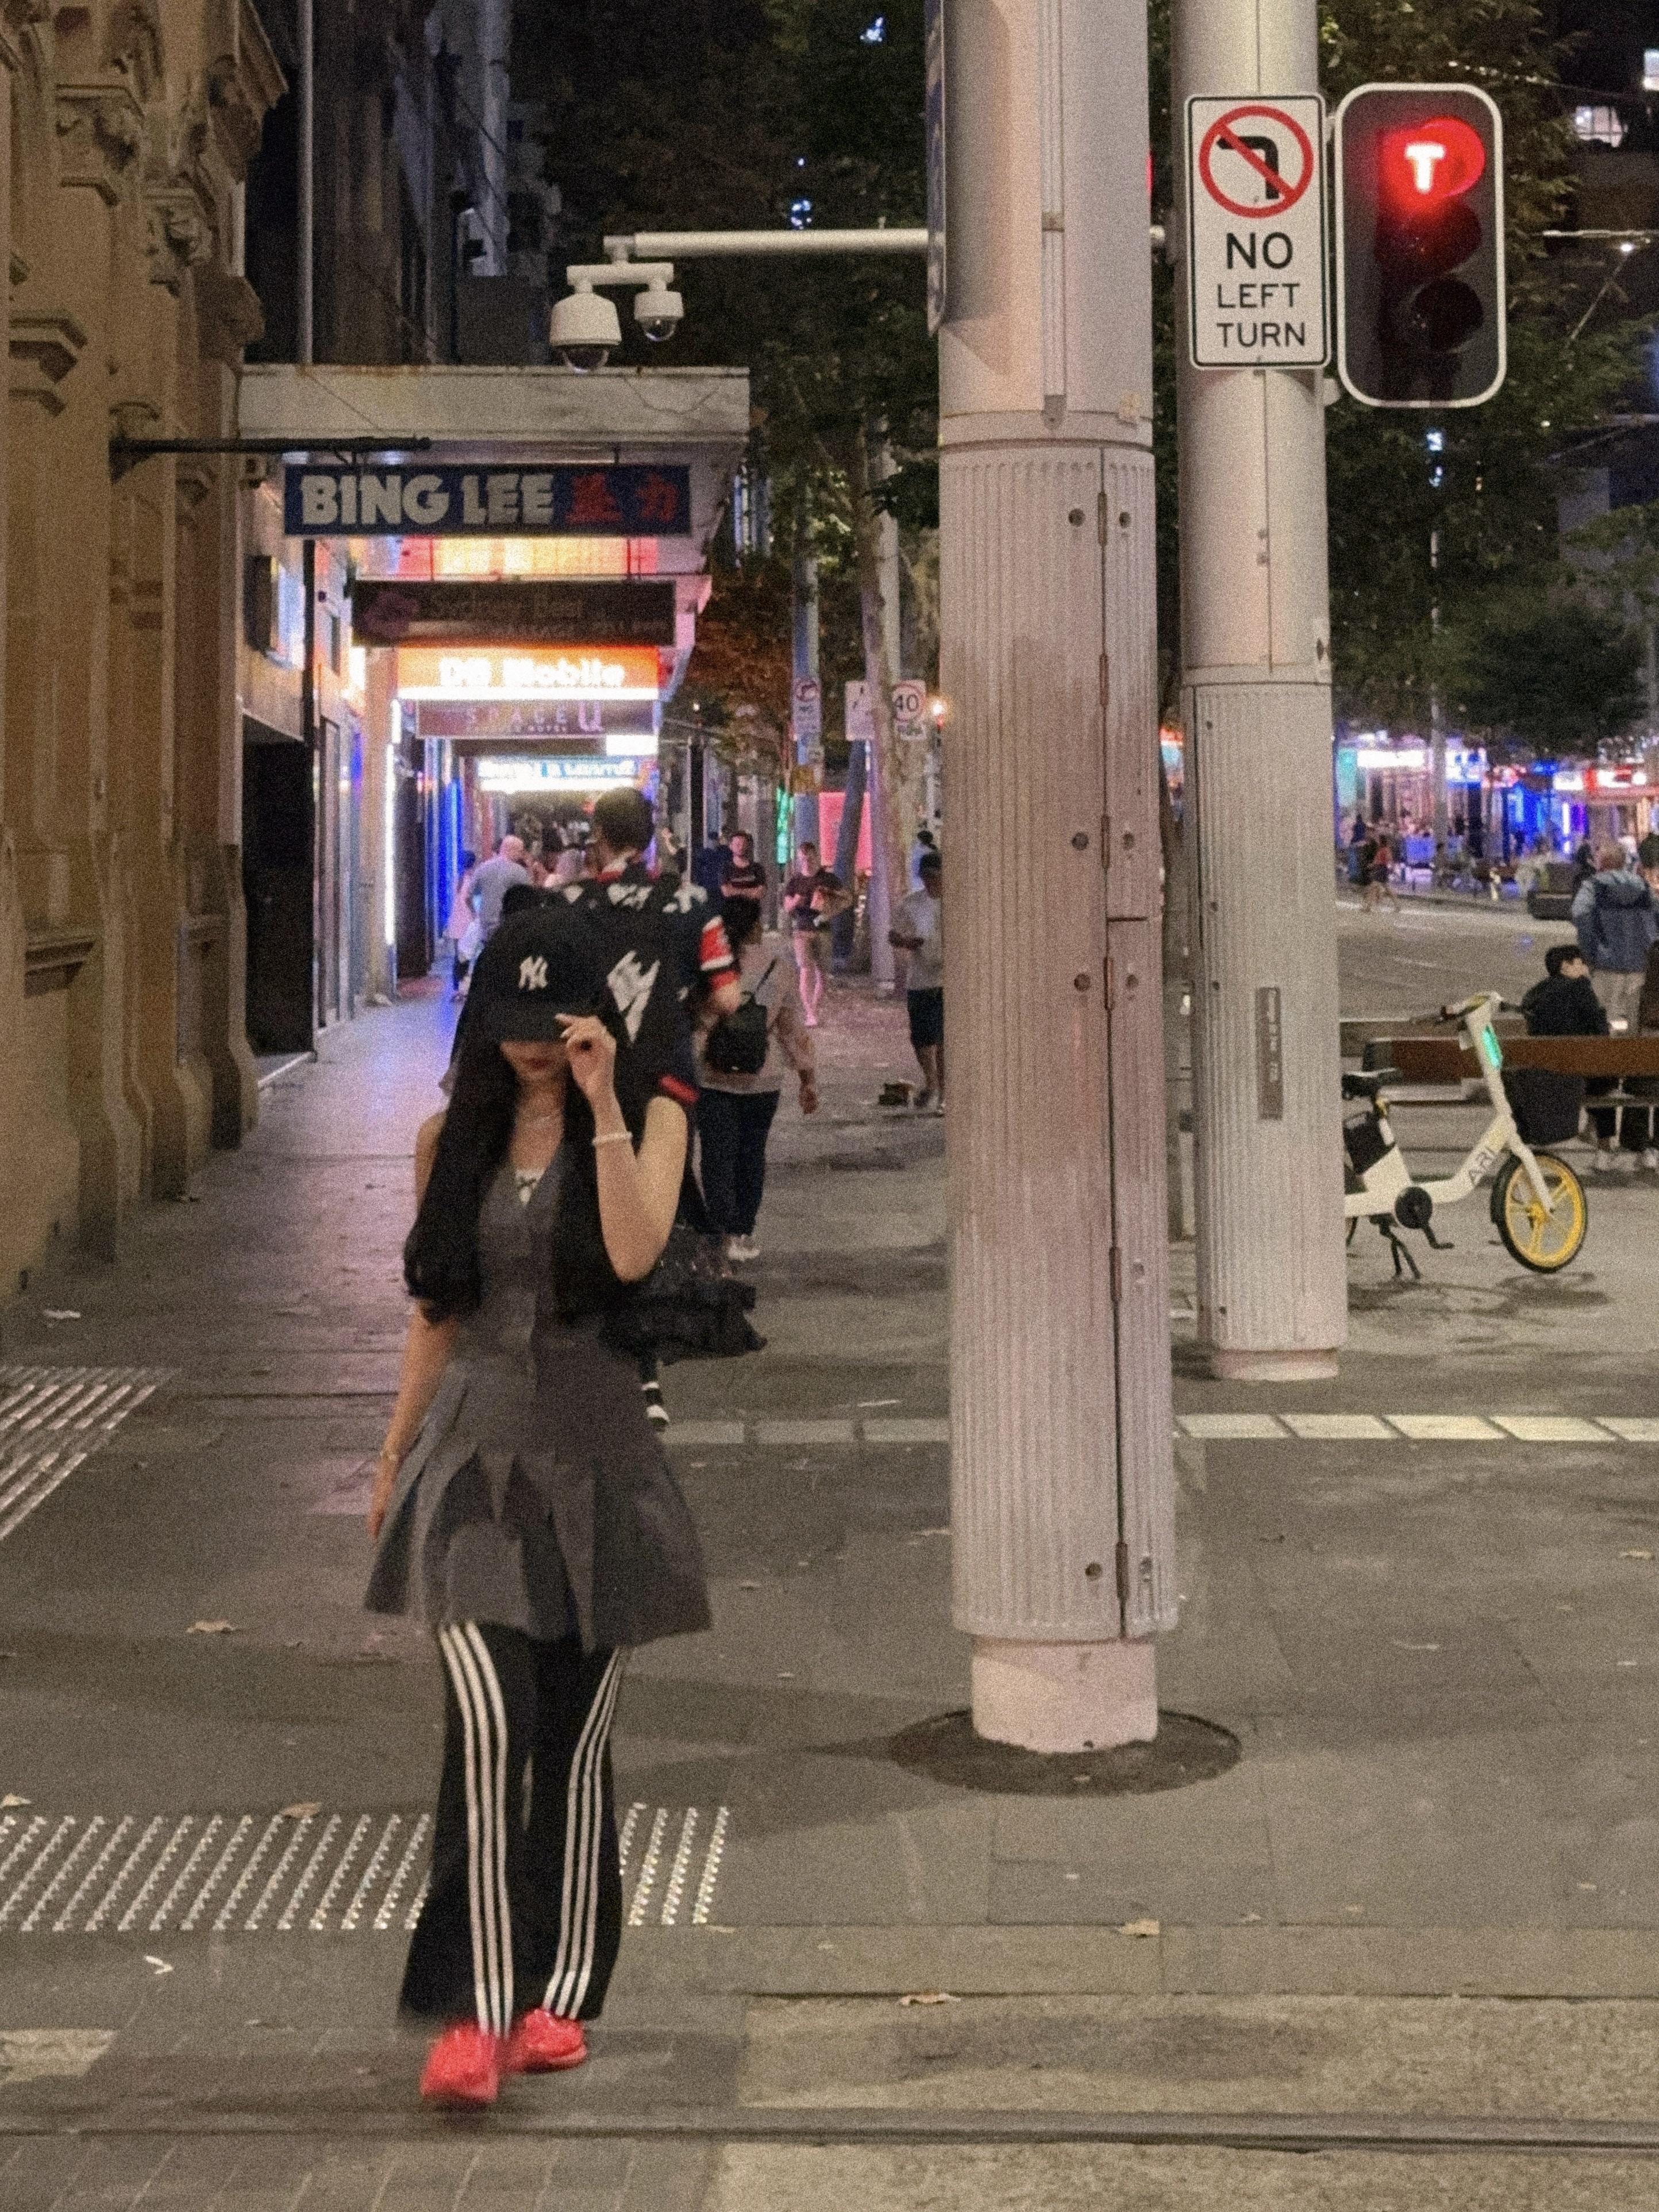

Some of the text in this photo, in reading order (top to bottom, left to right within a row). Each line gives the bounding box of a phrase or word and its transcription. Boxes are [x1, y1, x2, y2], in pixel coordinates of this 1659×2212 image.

[1404, 141, 1446, 194] T
[1226, 232, 1293, 270] NO
[1217, 283, 1300, 309] LEFT
[1216, 321, 1306, 347] TURN
[301, 473, 553, 526] BING LEE
[503, 657, 625, 688] Mobile
[465, 705, 567, 725] SPACE
[894, 694, 919, 712] 40
[518, 955, 548, 990] NY
